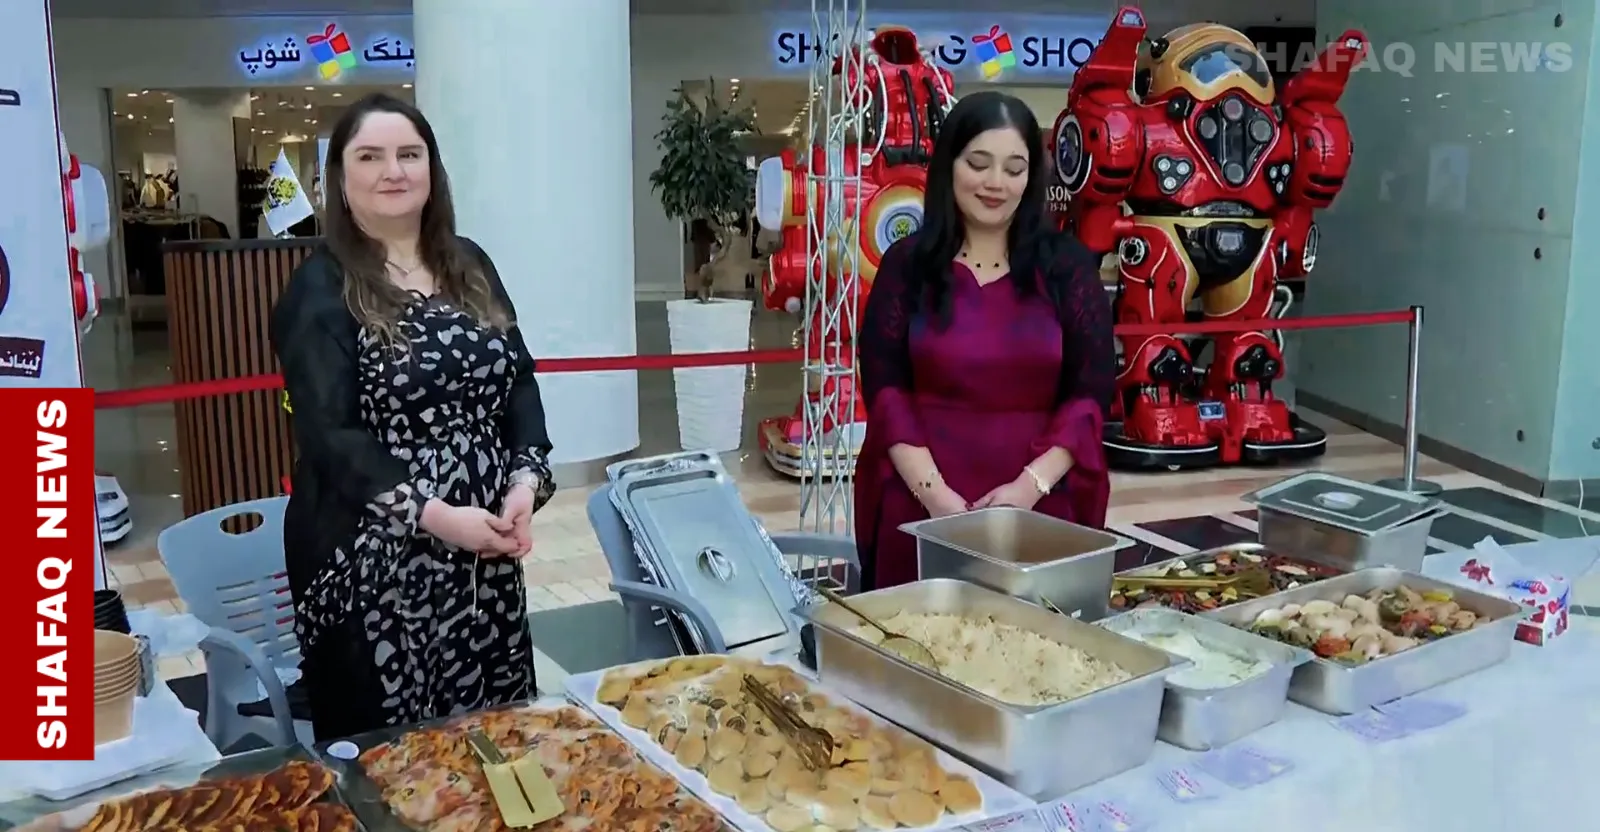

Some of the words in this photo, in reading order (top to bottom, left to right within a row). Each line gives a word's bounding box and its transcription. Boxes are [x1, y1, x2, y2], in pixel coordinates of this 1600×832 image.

[240, 37, 301, 74] شۆپ
[363, 37, 414, 67] ینگ
[1022, 35, 1103, 67] SHO
